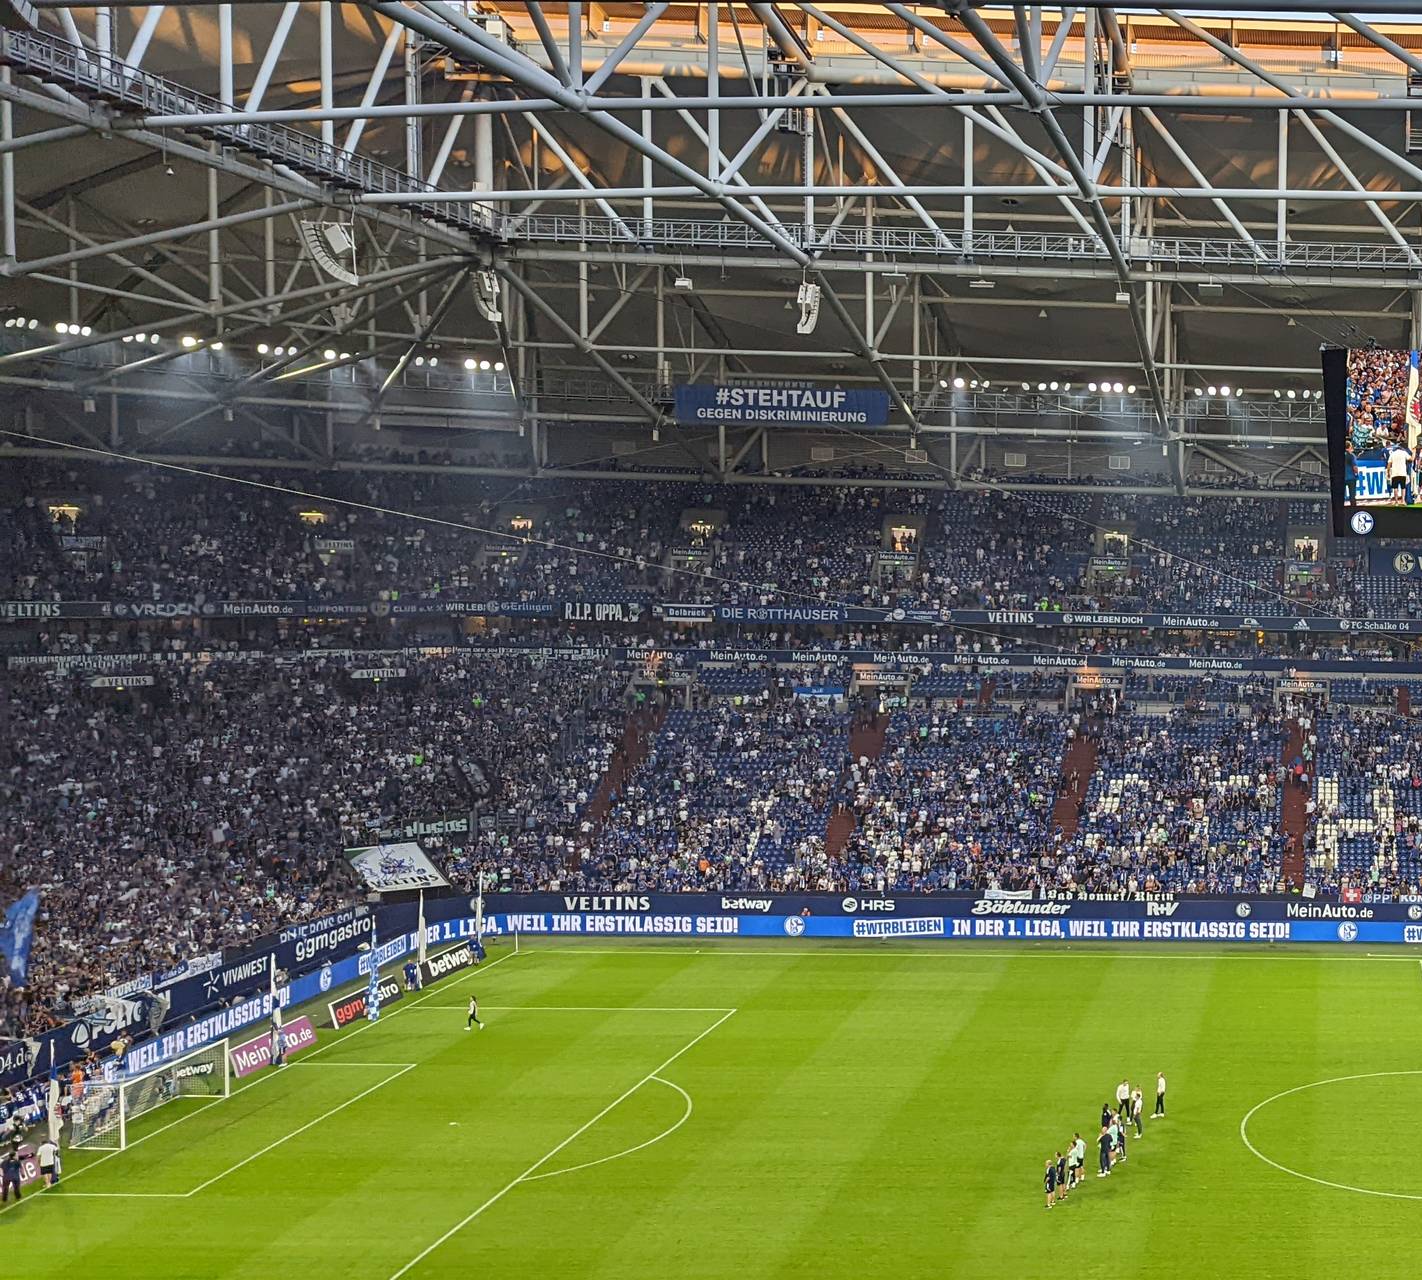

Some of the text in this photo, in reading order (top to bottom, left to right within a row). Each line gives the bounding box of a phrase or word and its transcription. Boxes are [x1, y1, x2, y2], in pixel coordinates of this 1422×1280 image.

[716, 387, 846, 408] #STEHTAUF
[697, 407, 867, 423] GEGEN DISKRIMINIERUNG
[131, 603, 200, 617] VREDEN
[223, 603, 294, 615] MeinAuto.de
[445, 603, 465, 611] WIR
[565, 602, 593, 621] R.I.P.
[722, 607, 744, 619] DIE
[988, 612, 1034, 624] VELTINS
[1074, 615, 1143, 625] WIR LEBEN DICH
[1163, 617, 1219, 628] MeinAuto.de
[1351, 621, 1410, 631] FC Schalke 04
[710, 651, 767, 661] MeinAuto.de
[792, 652, 848, 663] MeinAuto.de
[1033, 656, 1088, 667] MeinAuto.de
[1112, 657, 1166, 668] MeinAuto.de
[1189, 659, 1243, 670] MeinAuto.de
[108, 677, 148, 686] VELTINS
[860, 673, 904, 681] MeinAuto.de
[1077, 676, 1119, 684] MeinAuto.de
[1280, 680, 1323, 689] MeinAuto.de
[564, 896, 650, 911] VELTINS
[721, 897, 773, 912] betway
[861, 899, 895, 911] HRS
[971, 899, 1071, 915] Böklunder
[1286, 903, 1374, 918] MeinAuto.de
[443, 923, 457, 939] 1.
[507, 914, 548, 931] WEIL
[552, 914, 582, 932] IHR
[586, 914, 692, 933] ERSTKLASSIG
[696, 916, 739, 933] SEID!
[856, 918, 1290, 939] #WIRBLEIBEN IN DER 1. LIGA, WEIL IHR ERSTKLASSIG SEID!
[295, 917, 371, 962] ggmgastro
[223, 956, 268, 987] VIVAWEST
[128, 1045, 160, 1073] WEIL
[162, 1031, 184, 1058] IHR
[187, 997, 262, 1050] ERSTKLASSIG
